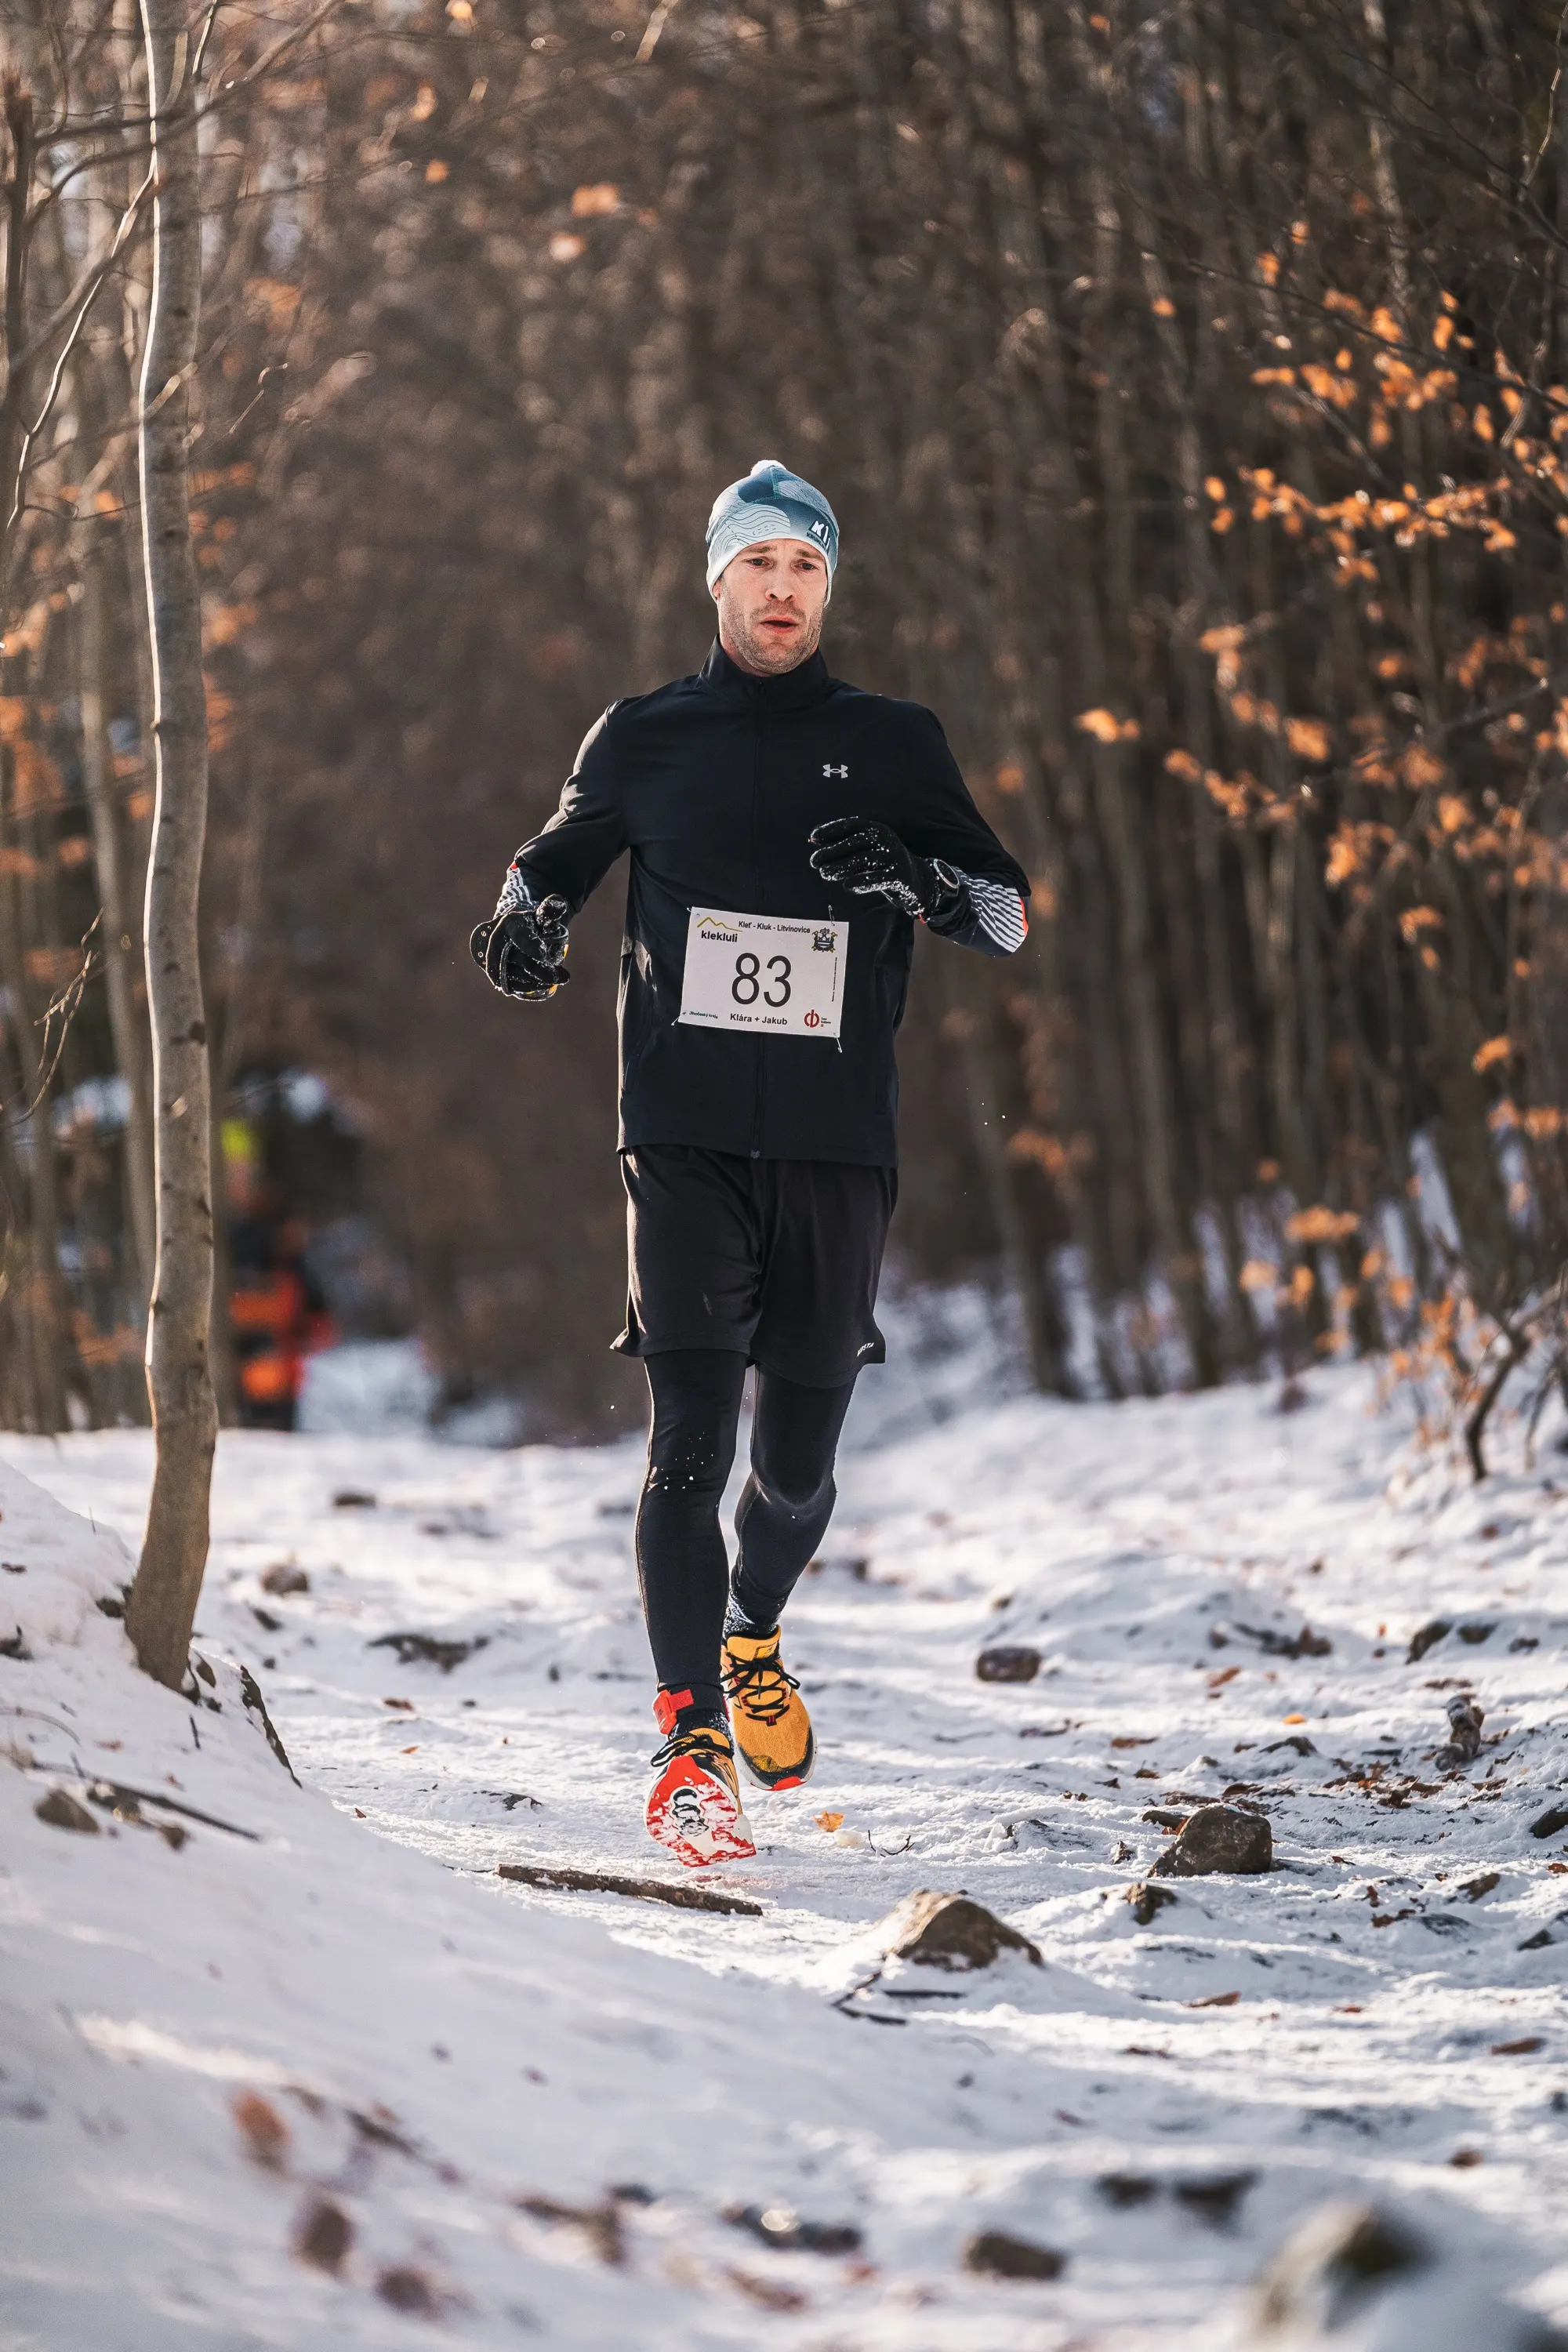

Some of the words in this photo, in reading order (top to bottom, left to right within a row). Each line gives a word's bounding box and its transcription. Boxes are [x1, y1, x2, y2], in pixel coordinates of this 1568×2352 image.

[757, 923, 771, 931] Kluk
[777, 925, 811, 934] Litvínovice
[701, 931, 738, 942] klekluli
[731, 953, 792, 1007] 83
[730, 1013, 753, 1022] Klára
[762, 1016, 788, 1025] Jakub
